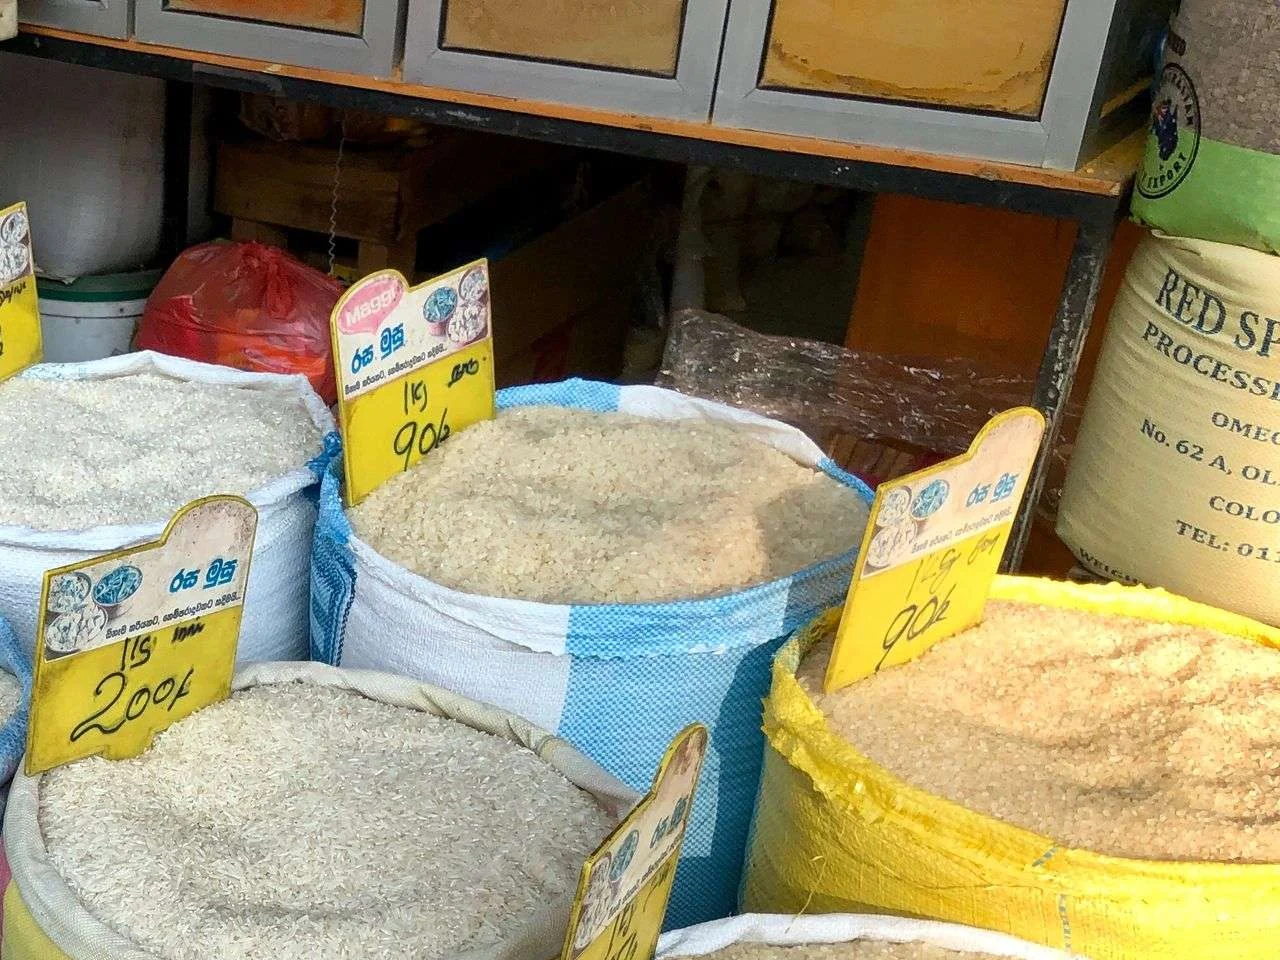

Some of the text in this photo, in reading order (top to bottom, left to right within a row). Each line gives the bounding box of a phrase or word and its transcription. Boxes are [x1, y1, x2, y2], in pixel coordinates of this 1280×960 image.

[1155, 264, 1227, 335] RED
[351, 344, 374, 375] රස
[1140, 418, 1170, 447] No.
[1175, 440, 1204, 462] 62
[1176, 519, 1230, 552] TEL:
[169, 566, 200, 594] රස
